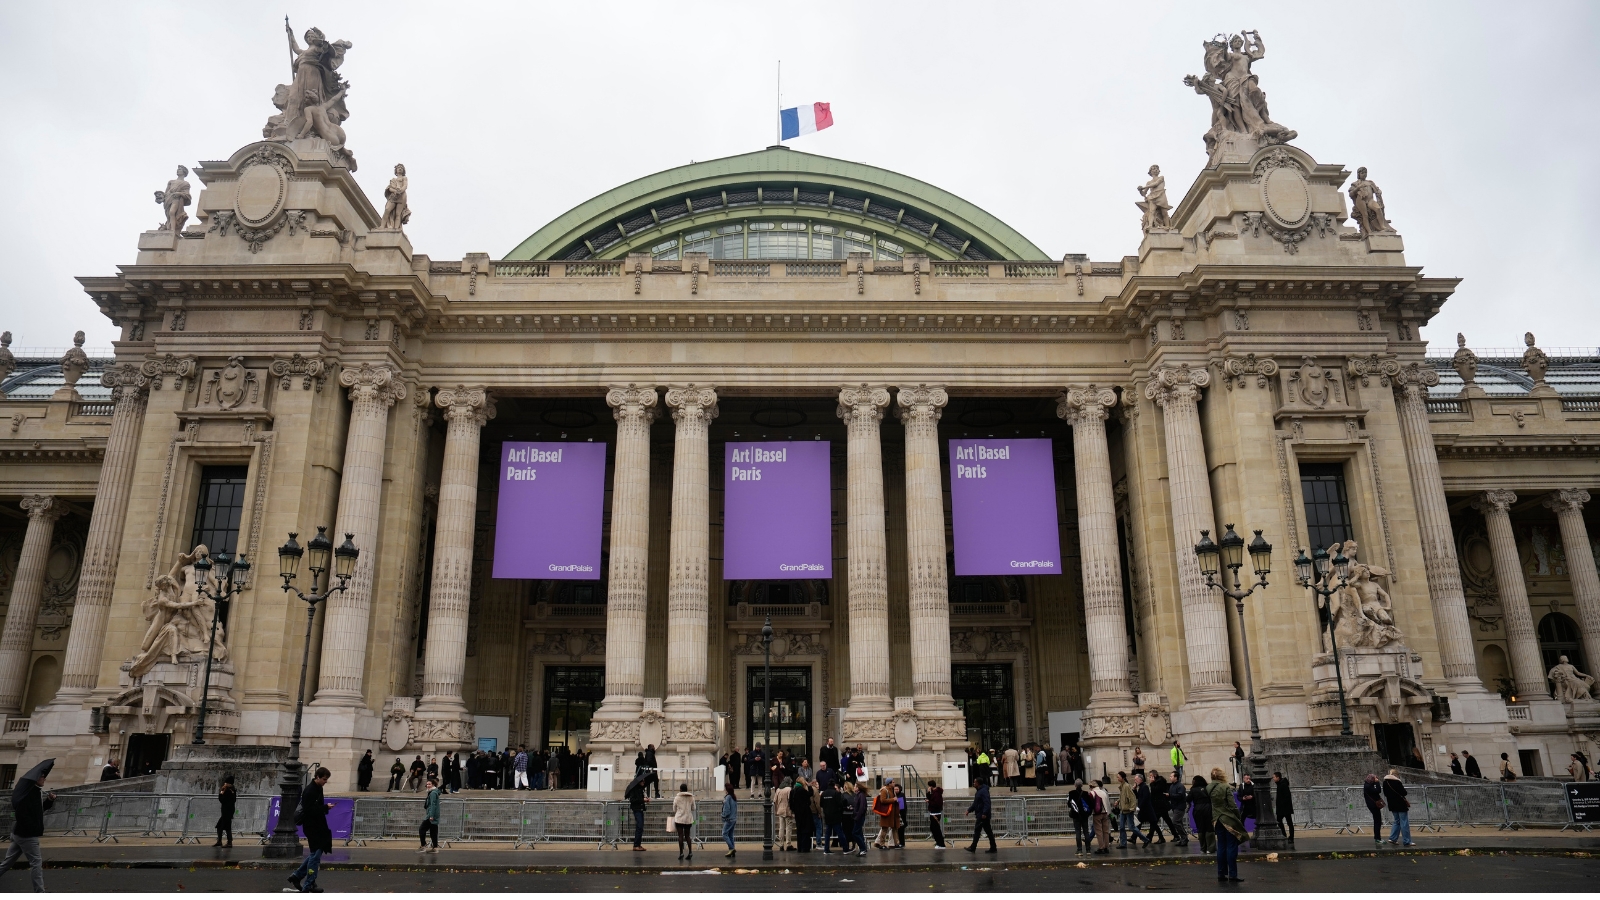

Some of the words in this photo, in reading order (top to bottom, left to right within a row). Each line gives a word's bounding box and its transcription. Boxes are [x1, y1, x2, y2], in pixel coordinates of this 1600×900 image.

[507, 466, 537, 481] Paris
[732, 466, 762, 481] Paris
[957, 464, 987, 479] Paris
[548, 563, 593, 572] GrandPalais
[779, 563, 824, 571] GrandPalais
[1010, 560, 1054, 568] GrandPalais
